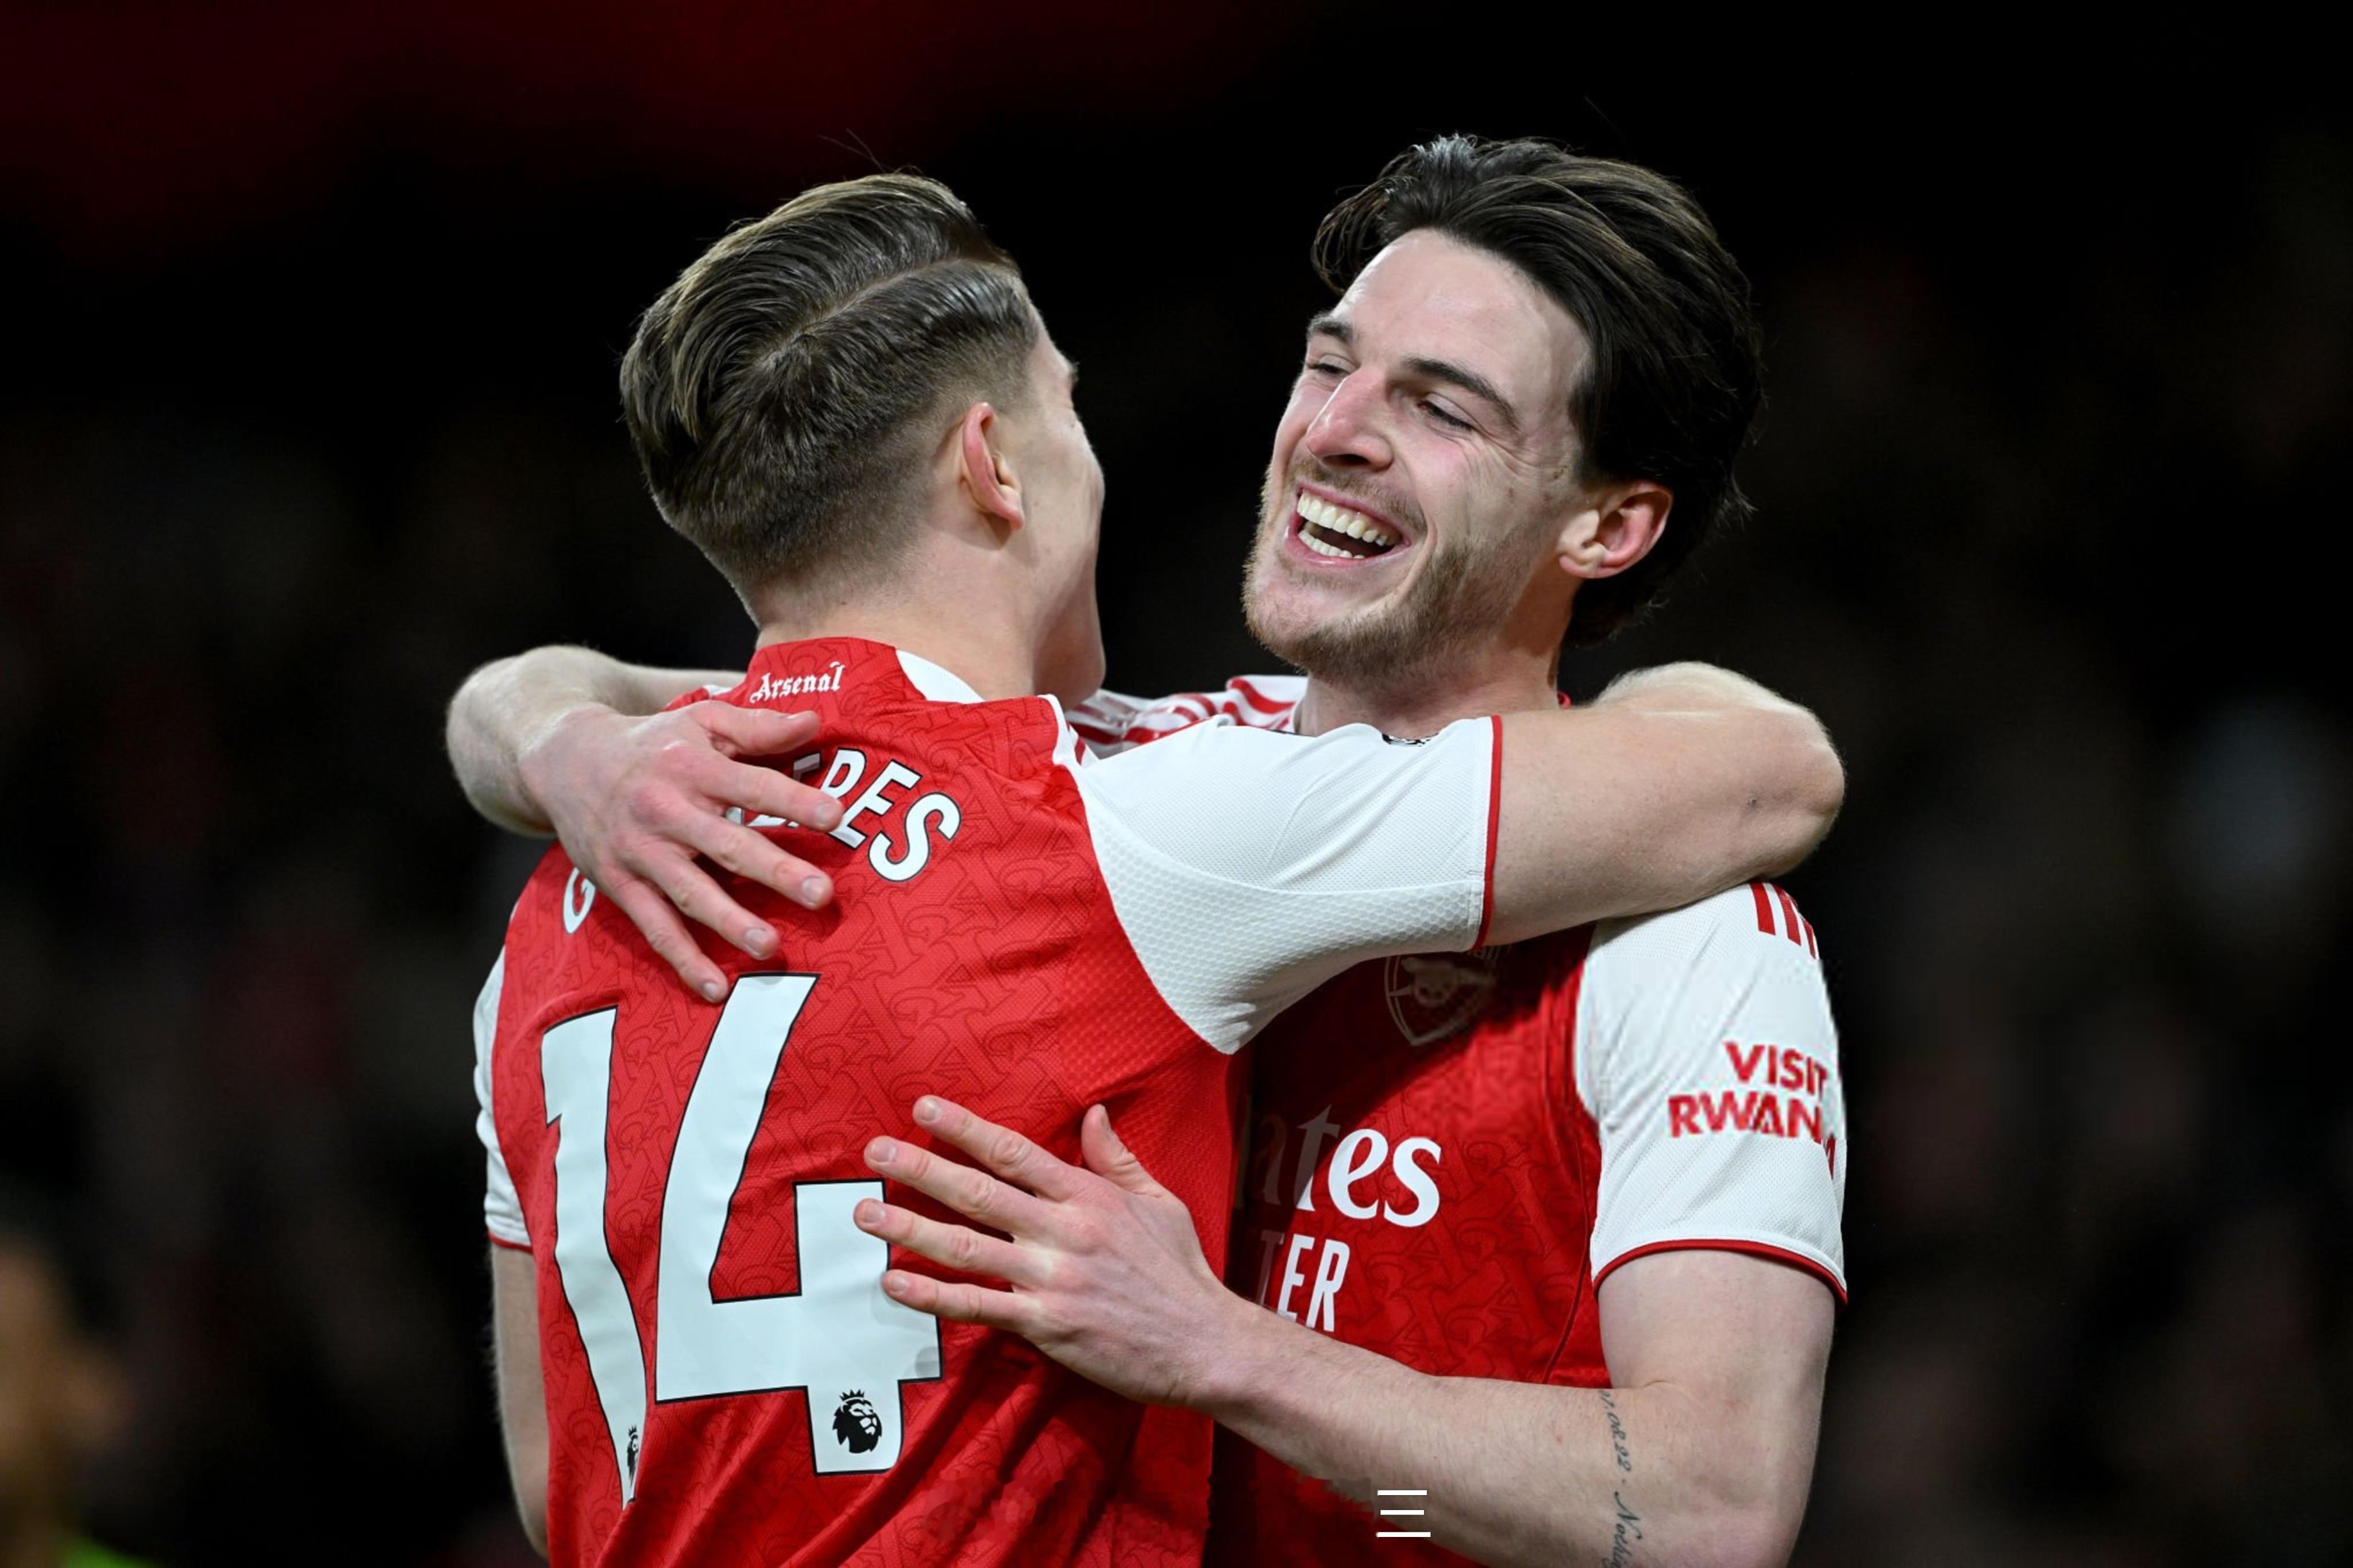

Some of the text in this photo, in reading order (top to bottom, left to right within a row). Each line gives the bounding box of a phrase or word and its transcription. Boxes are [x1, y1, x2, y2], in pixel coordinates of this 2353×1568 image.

[749, 661, 846, 704] Arsenal
[1724, 1041, 1828, 1103] VISIT
[1668, 1091, 1837, 1180] RWAN
[540, 972, 943, 1509] 14
[1258, 1229, 1351, 1333] TER
